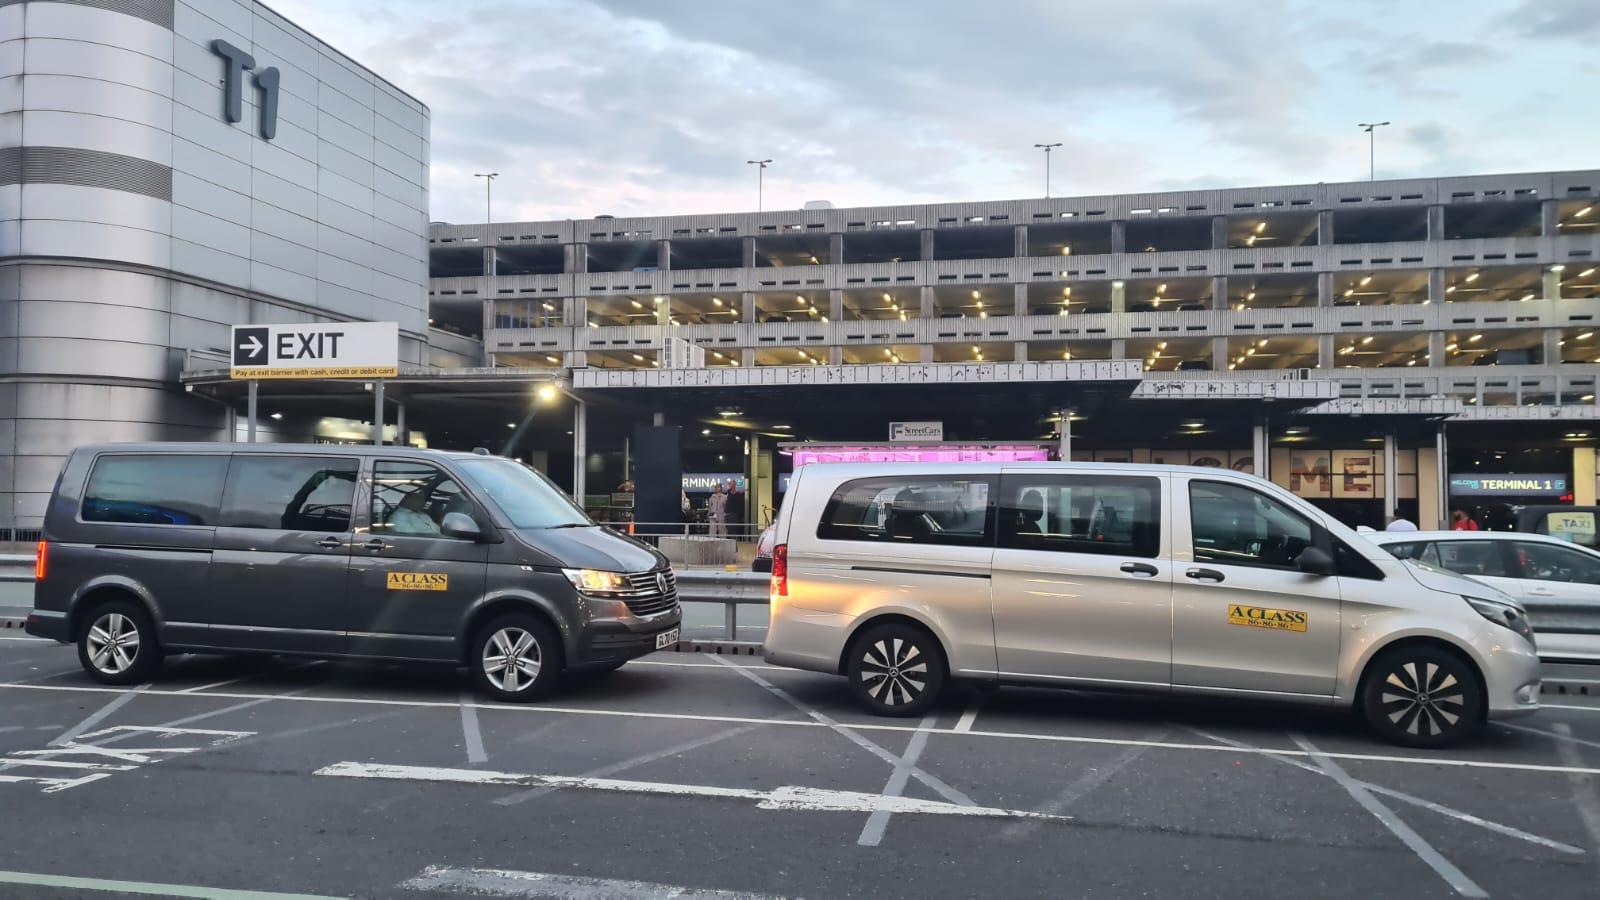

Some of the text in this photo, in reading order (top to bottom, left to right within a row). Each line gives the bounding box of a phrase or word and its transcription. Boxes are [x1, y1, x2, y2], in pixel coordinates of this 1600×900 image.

[208, 38, 281, 140] T1
[276, 332, 345, 359] EXIT
[235, 369, 248, 377] Pay
[257, 368, 270, 376] exit
[271, 368, 293, 376] barrier
[295, 368, 309, 376] with
[310, 368, 328, 376] cash,
[330, 367, 350, 375] credit
[360, 367, 378, 375] debit
[379, 367, 394, 375] card
[682, 477, 724, 488] RMINAL
[1480, 479, 1552, 490] TERMINAL 1
[1562, 518, 1591, 529] TAXI
[389, 573, 446, 584] A CLASS
[1231, 606, 1305, 624] A CLASS
